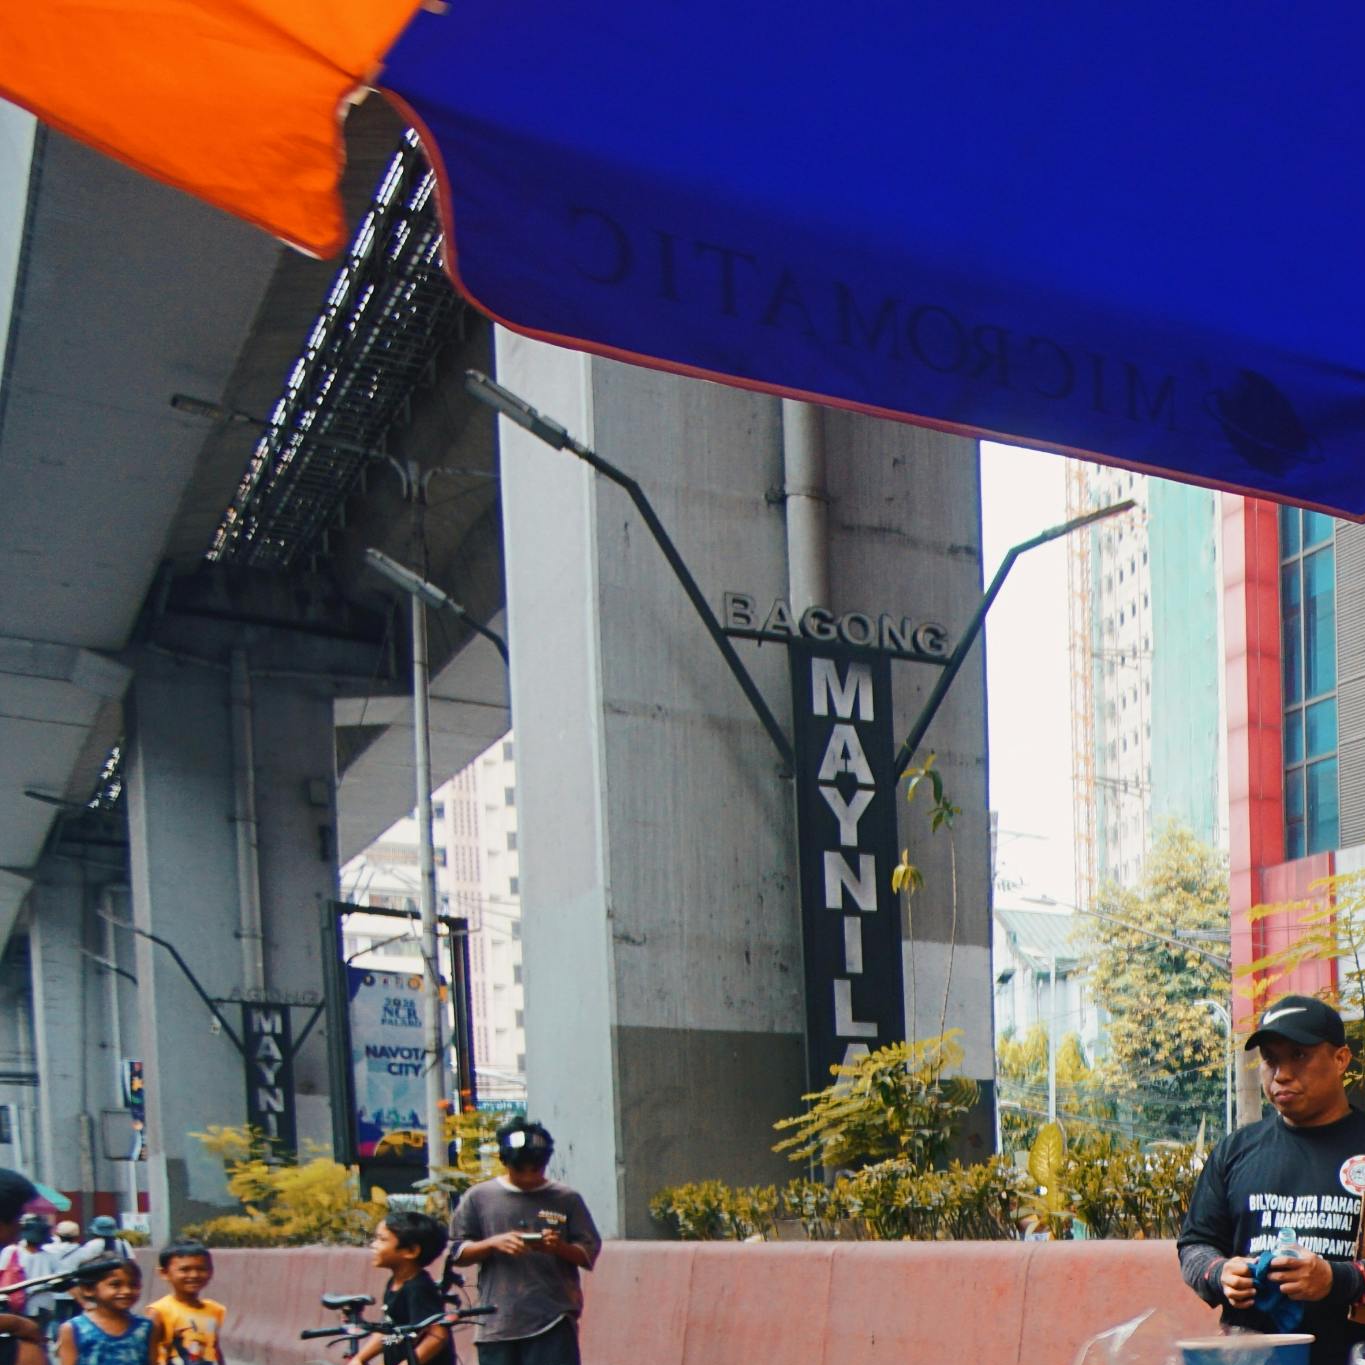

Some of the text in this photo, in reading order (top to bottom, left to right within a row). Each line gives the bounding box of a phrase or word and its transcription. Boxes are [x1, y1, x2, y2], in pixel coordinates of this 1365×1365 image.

[722, 591, 951, 657] BAGONG
[383, 1007, 419, 1019] NCR
[366, 1045, 427, 1061] NAVOT
[387, 1063, 423, 1077] CITY
[1249, 1193, 1361, 1215] BILYONG KITA IBAHAG
[1274, 1212, 1353, 1231] MANGGAGAWA!
